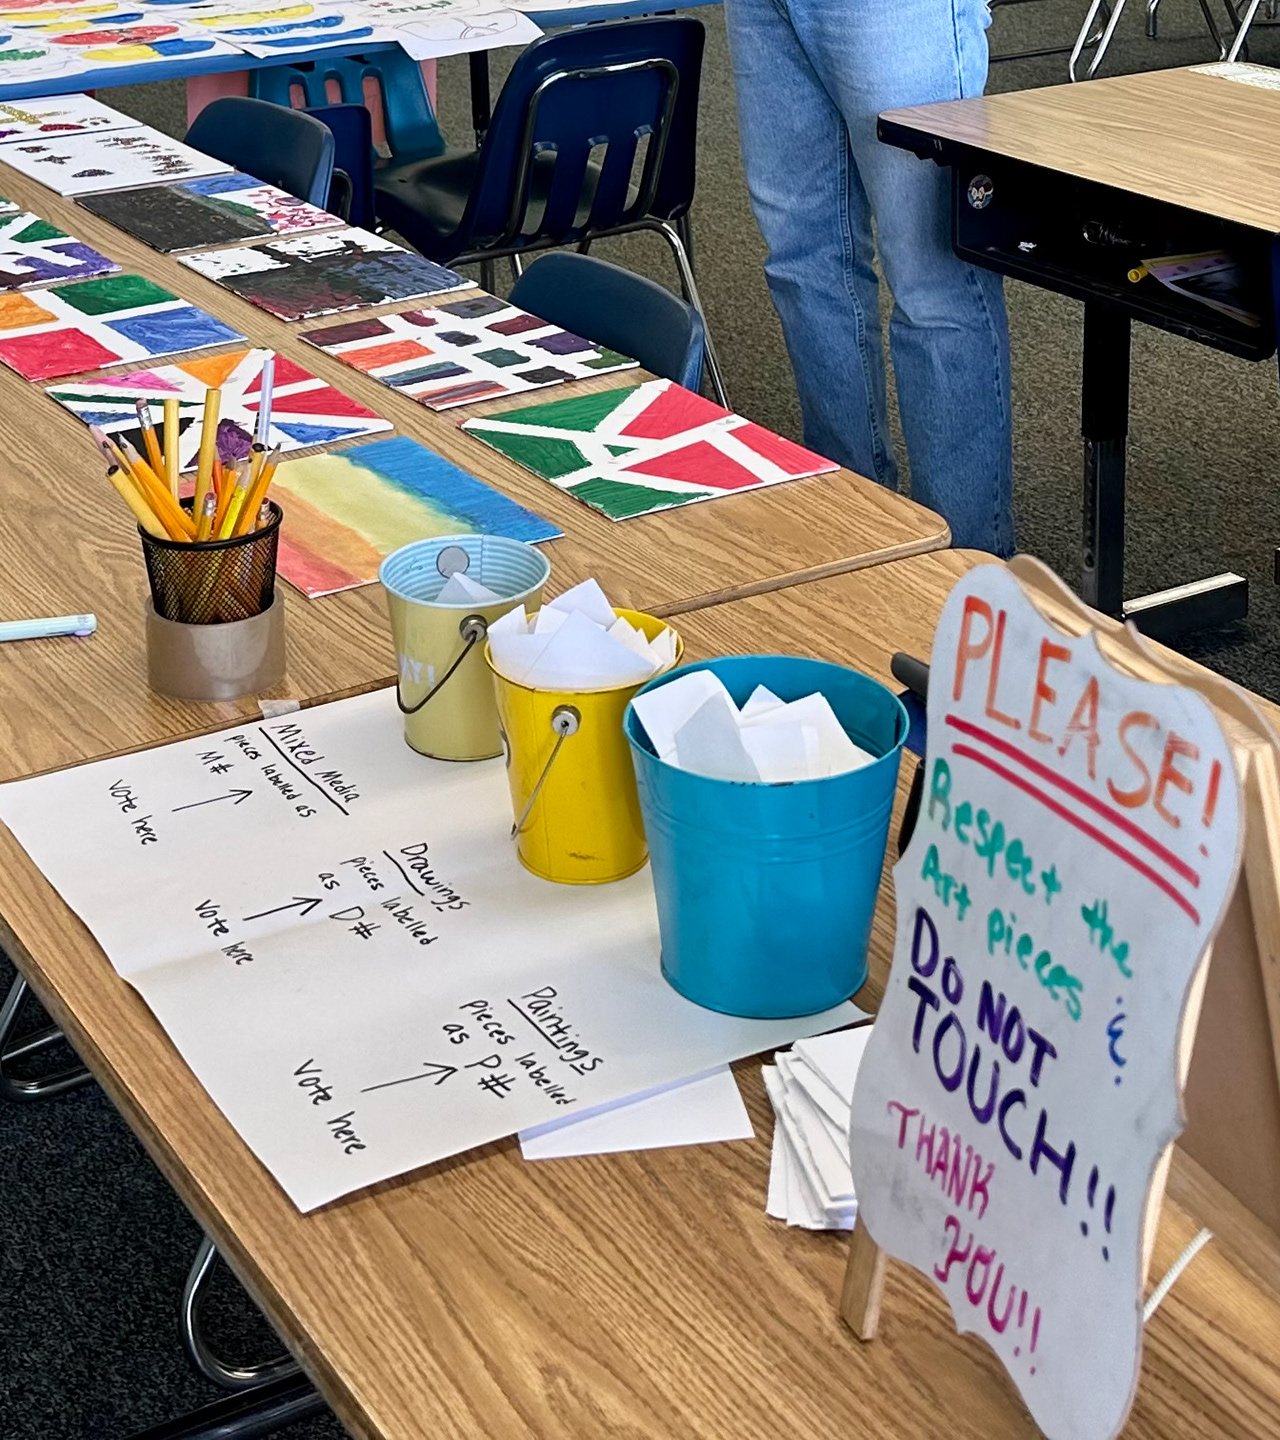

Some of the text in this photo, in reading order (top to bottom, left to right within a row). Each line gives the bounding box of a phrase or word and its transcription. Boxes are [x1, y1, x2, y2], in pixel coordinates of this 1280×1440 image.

[952, 594, 1222, 859] PLEASE!
[261, 765, 297, 801] labelled
[295, 804, 317, 819] as
[272, 724, 361, 804] Mixed Media
[131, 815, 158, 846] here
[318, 872, 341, 891] as
[400, 842, 471, 911] Drawings
[921, 844, 972, 921] Art
[928, 757, 1134, 980] Respect the
[221, 940, 254, 966] here
[381, 896, 439, 946] labelled
[442, 1023, 470, 1044] as
[521, 986, 604, 1072] Paintings
[976, 980, 1058, 1087] NOT
[515, 1052, 577, 1105] labelled
[327, 1110, 367, 1155] here
[907, 975, 1117, 1262] TOUCH!!
[887, 1100, 996, 1220] THANK
[933, 1215, 1042, 1375] YOU!!
